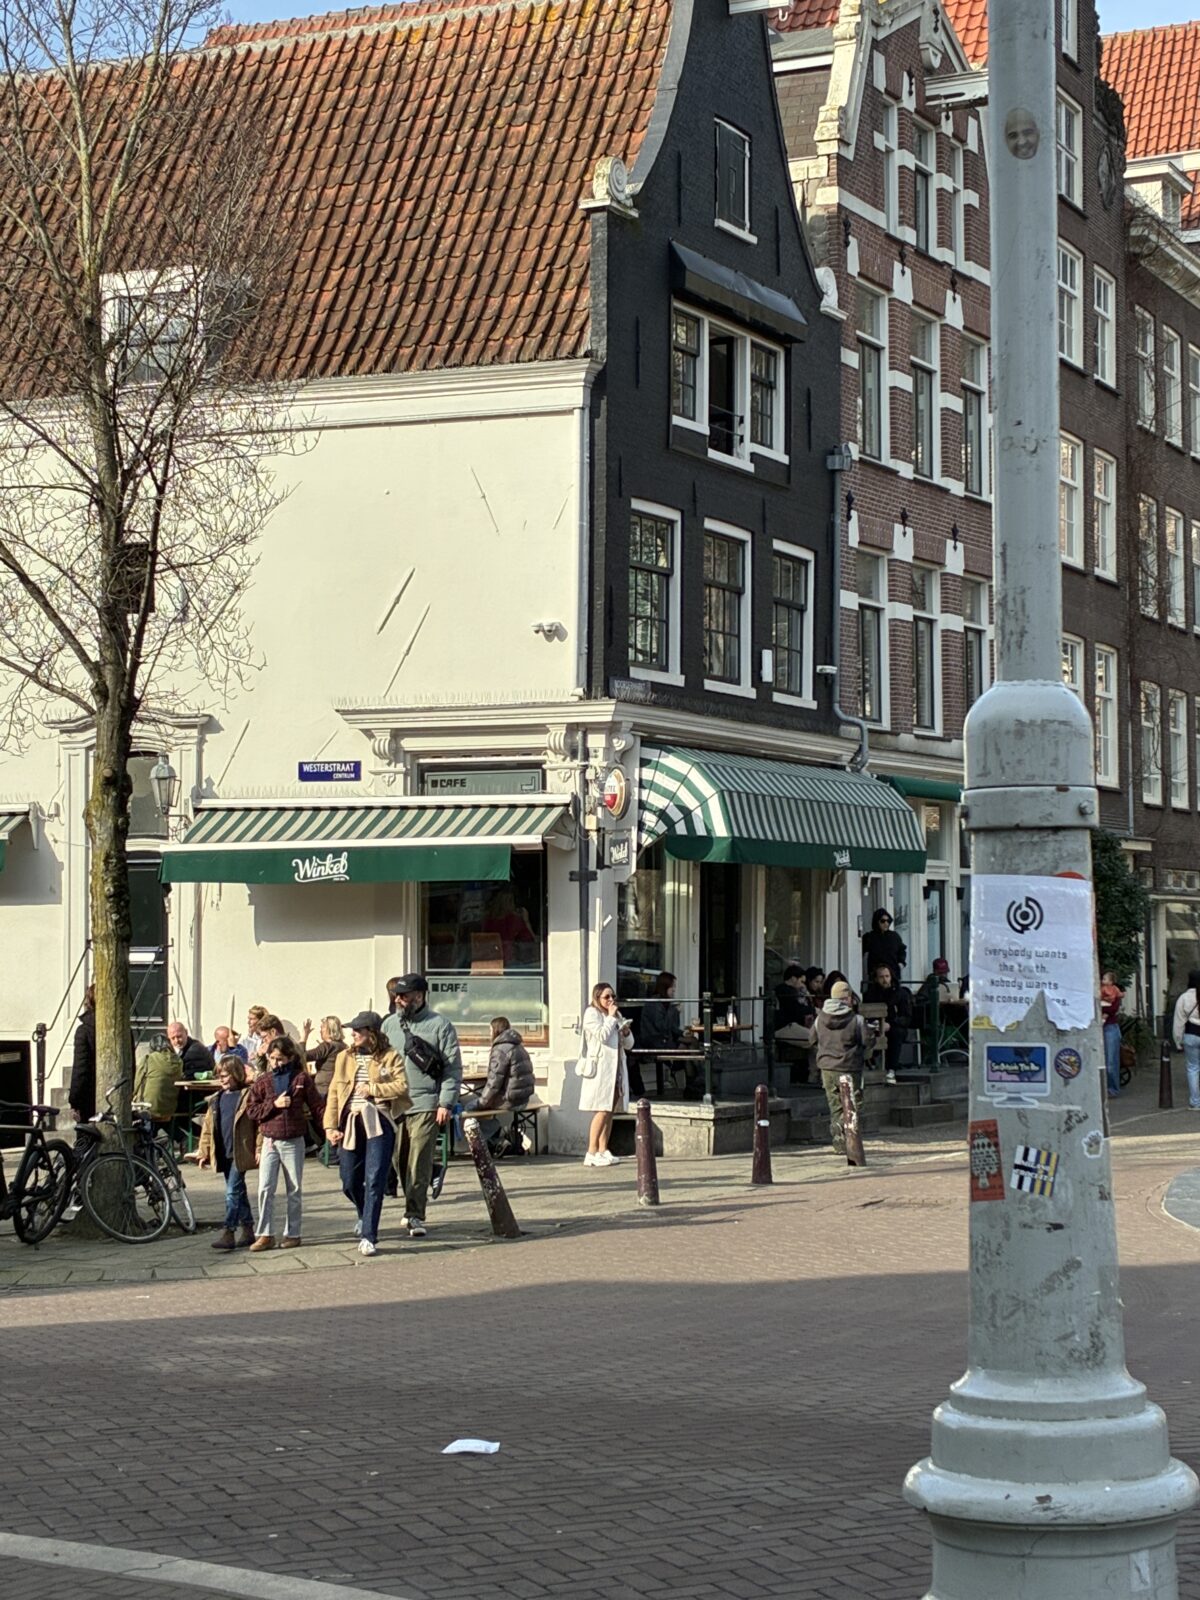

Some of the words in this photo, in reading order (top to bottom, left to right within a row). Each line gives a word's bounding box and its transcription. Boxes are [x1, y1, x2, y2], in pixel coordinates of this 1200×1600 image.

[302, 763, 355, 772] WESTERSTRAAT
[440, 778, 467, 788] CAFE
[291, 851, 350, 883] Winkel
[984, 946, 1033, 959] Everybody
[1035, 949, 1068, 959] wants
[999, 962, 1014, 973] the
[1025, 980, 1059, 990] wants
